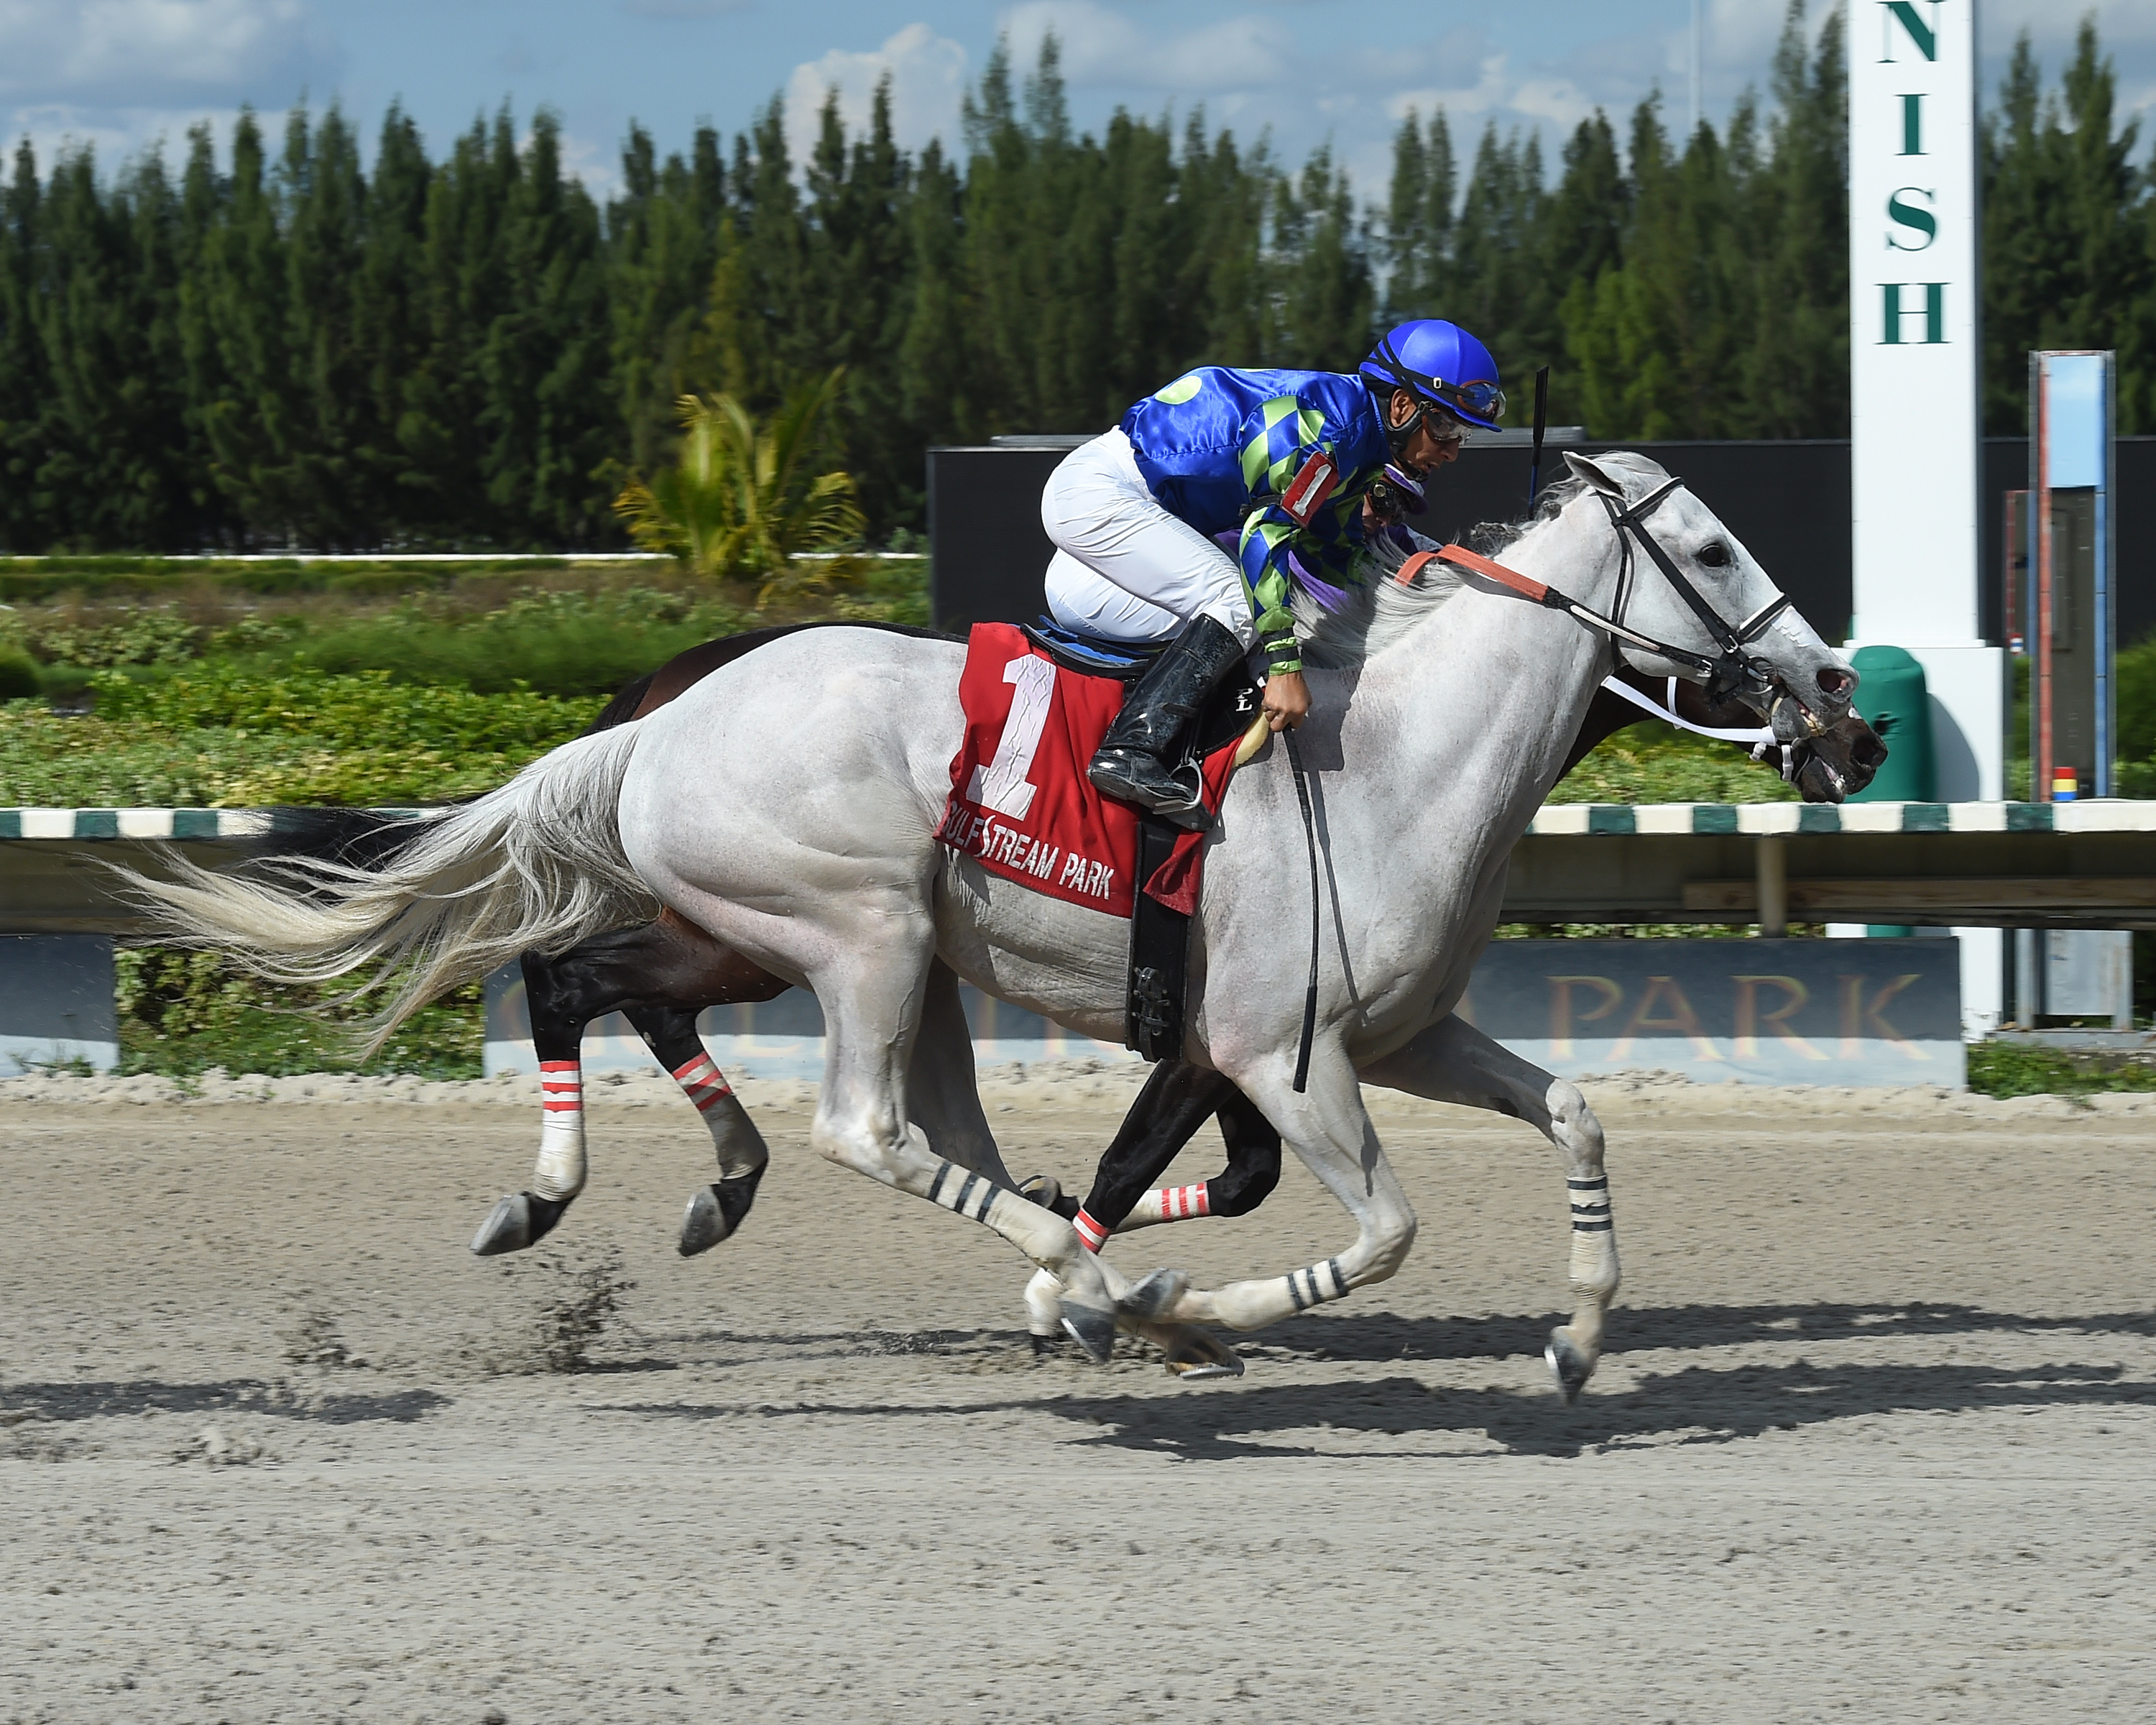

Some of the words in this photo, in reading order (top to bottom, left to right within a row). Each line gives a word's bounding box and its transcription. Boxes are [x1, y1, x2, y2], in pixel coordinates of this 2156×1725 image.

[1873, 0, 1953, 345] NISH
[1291, 463, 1332, 517] 1
[964, 653, 1057, 822] 1
[1058, 852, 1115, 900] PARK
[1544, 974, 1935, 1062] PARK
